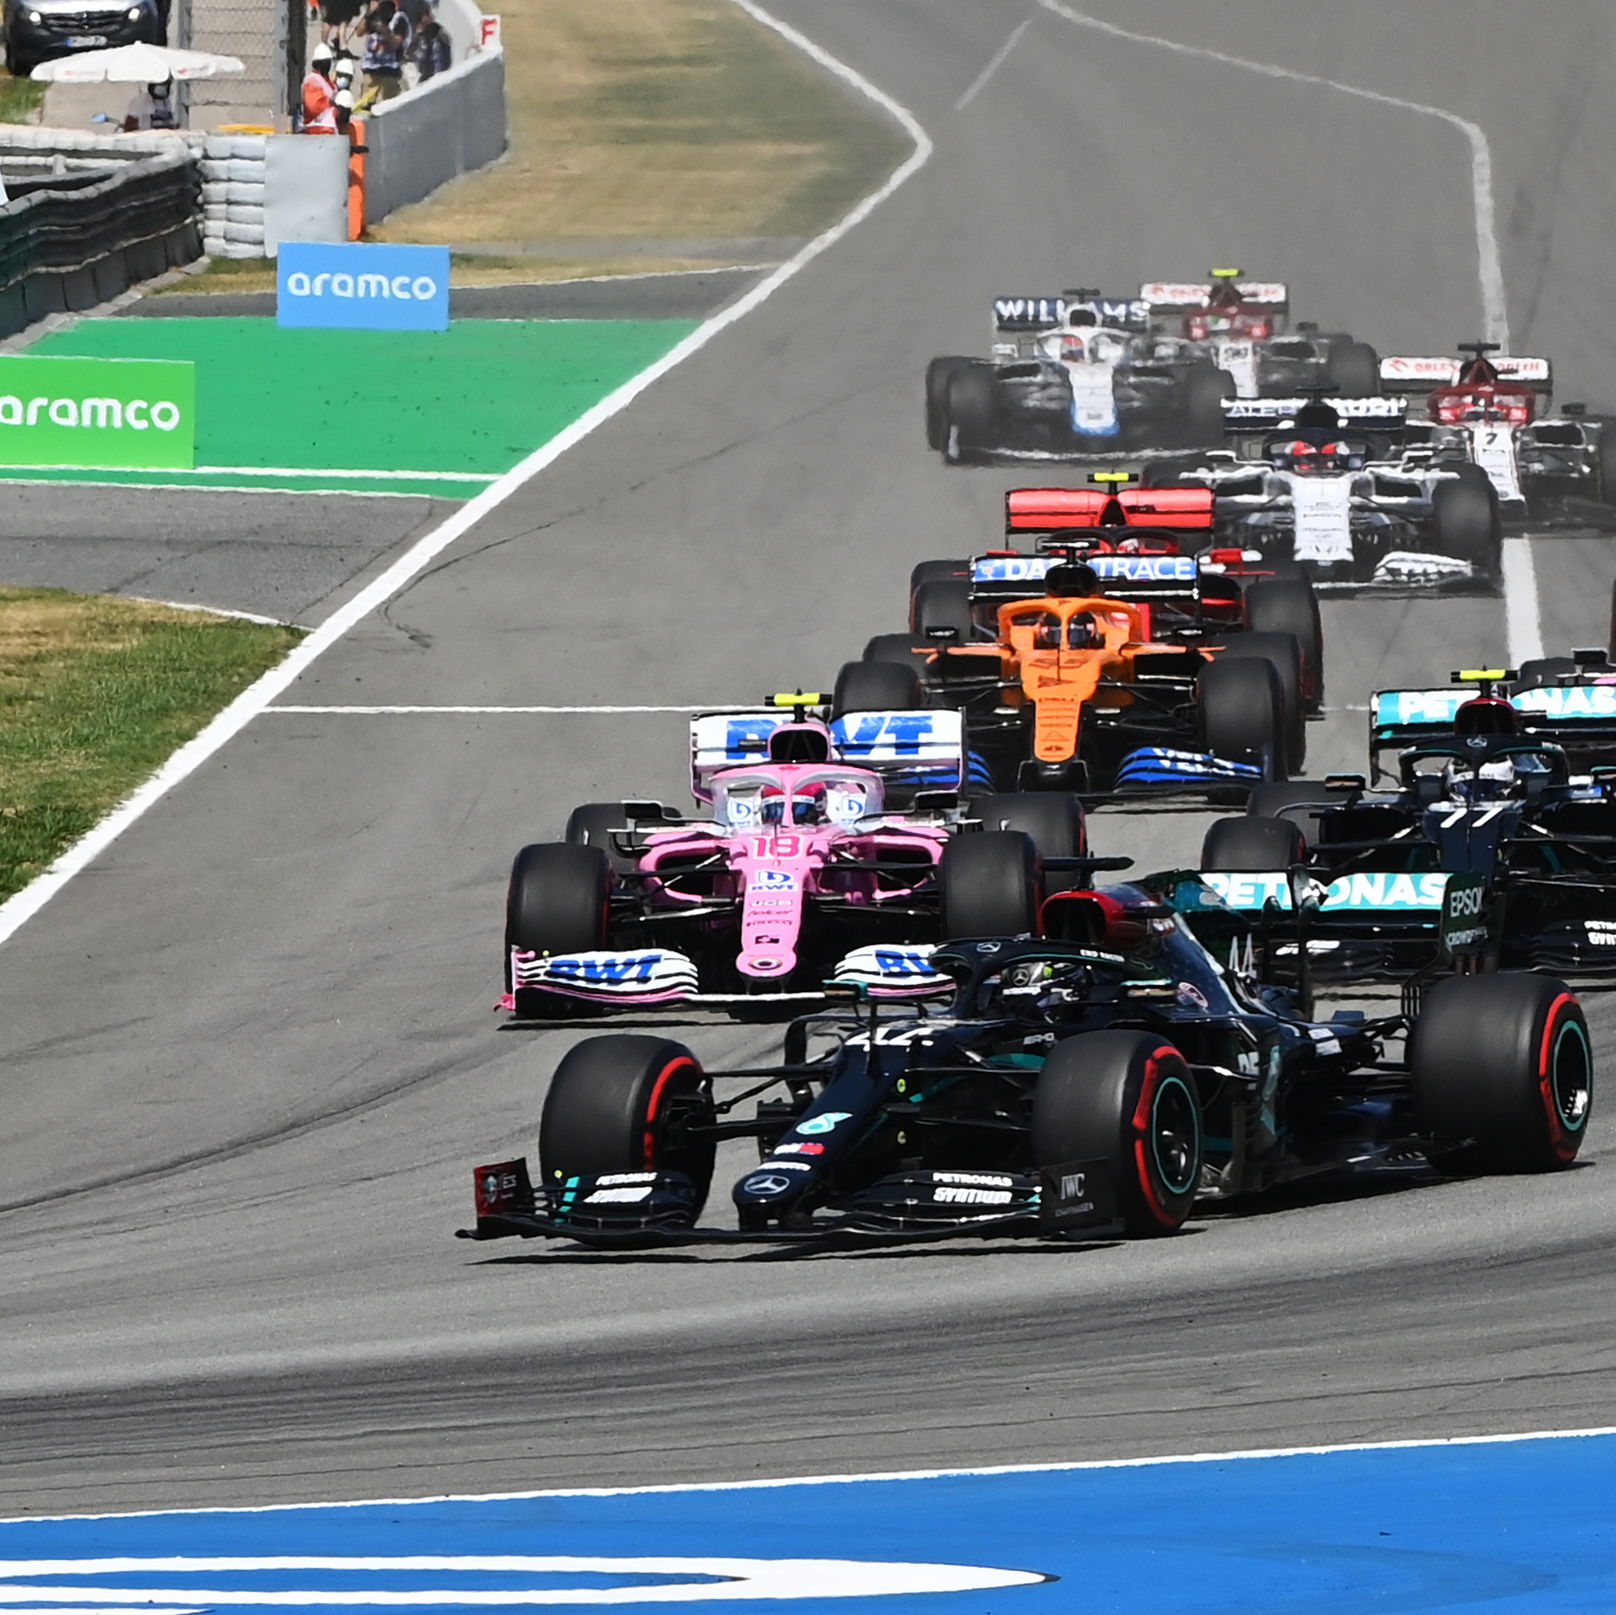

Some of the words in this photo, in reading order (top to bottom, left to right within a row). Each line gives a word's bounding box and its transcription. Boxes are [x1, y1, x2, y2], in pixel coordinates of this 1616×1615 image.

[482, 18, 498, 46] F
[287, 271, 438, 301] aramco
[0, 395, 181, 432] aramco
[1486, 432, 1498, 444] 7
[1005, 557, 1193, 580] DATRACE
[1440, 804, 1503, 828] 77
[754, 836, 800, 857] 18
[1199, 872, 1453, 906] PETONAS
[546, 954, 662, 984] BWT
[933, 1172, 1013, 1187] PETRONAS
[1061, 1173, 1085, 1200] IWC
